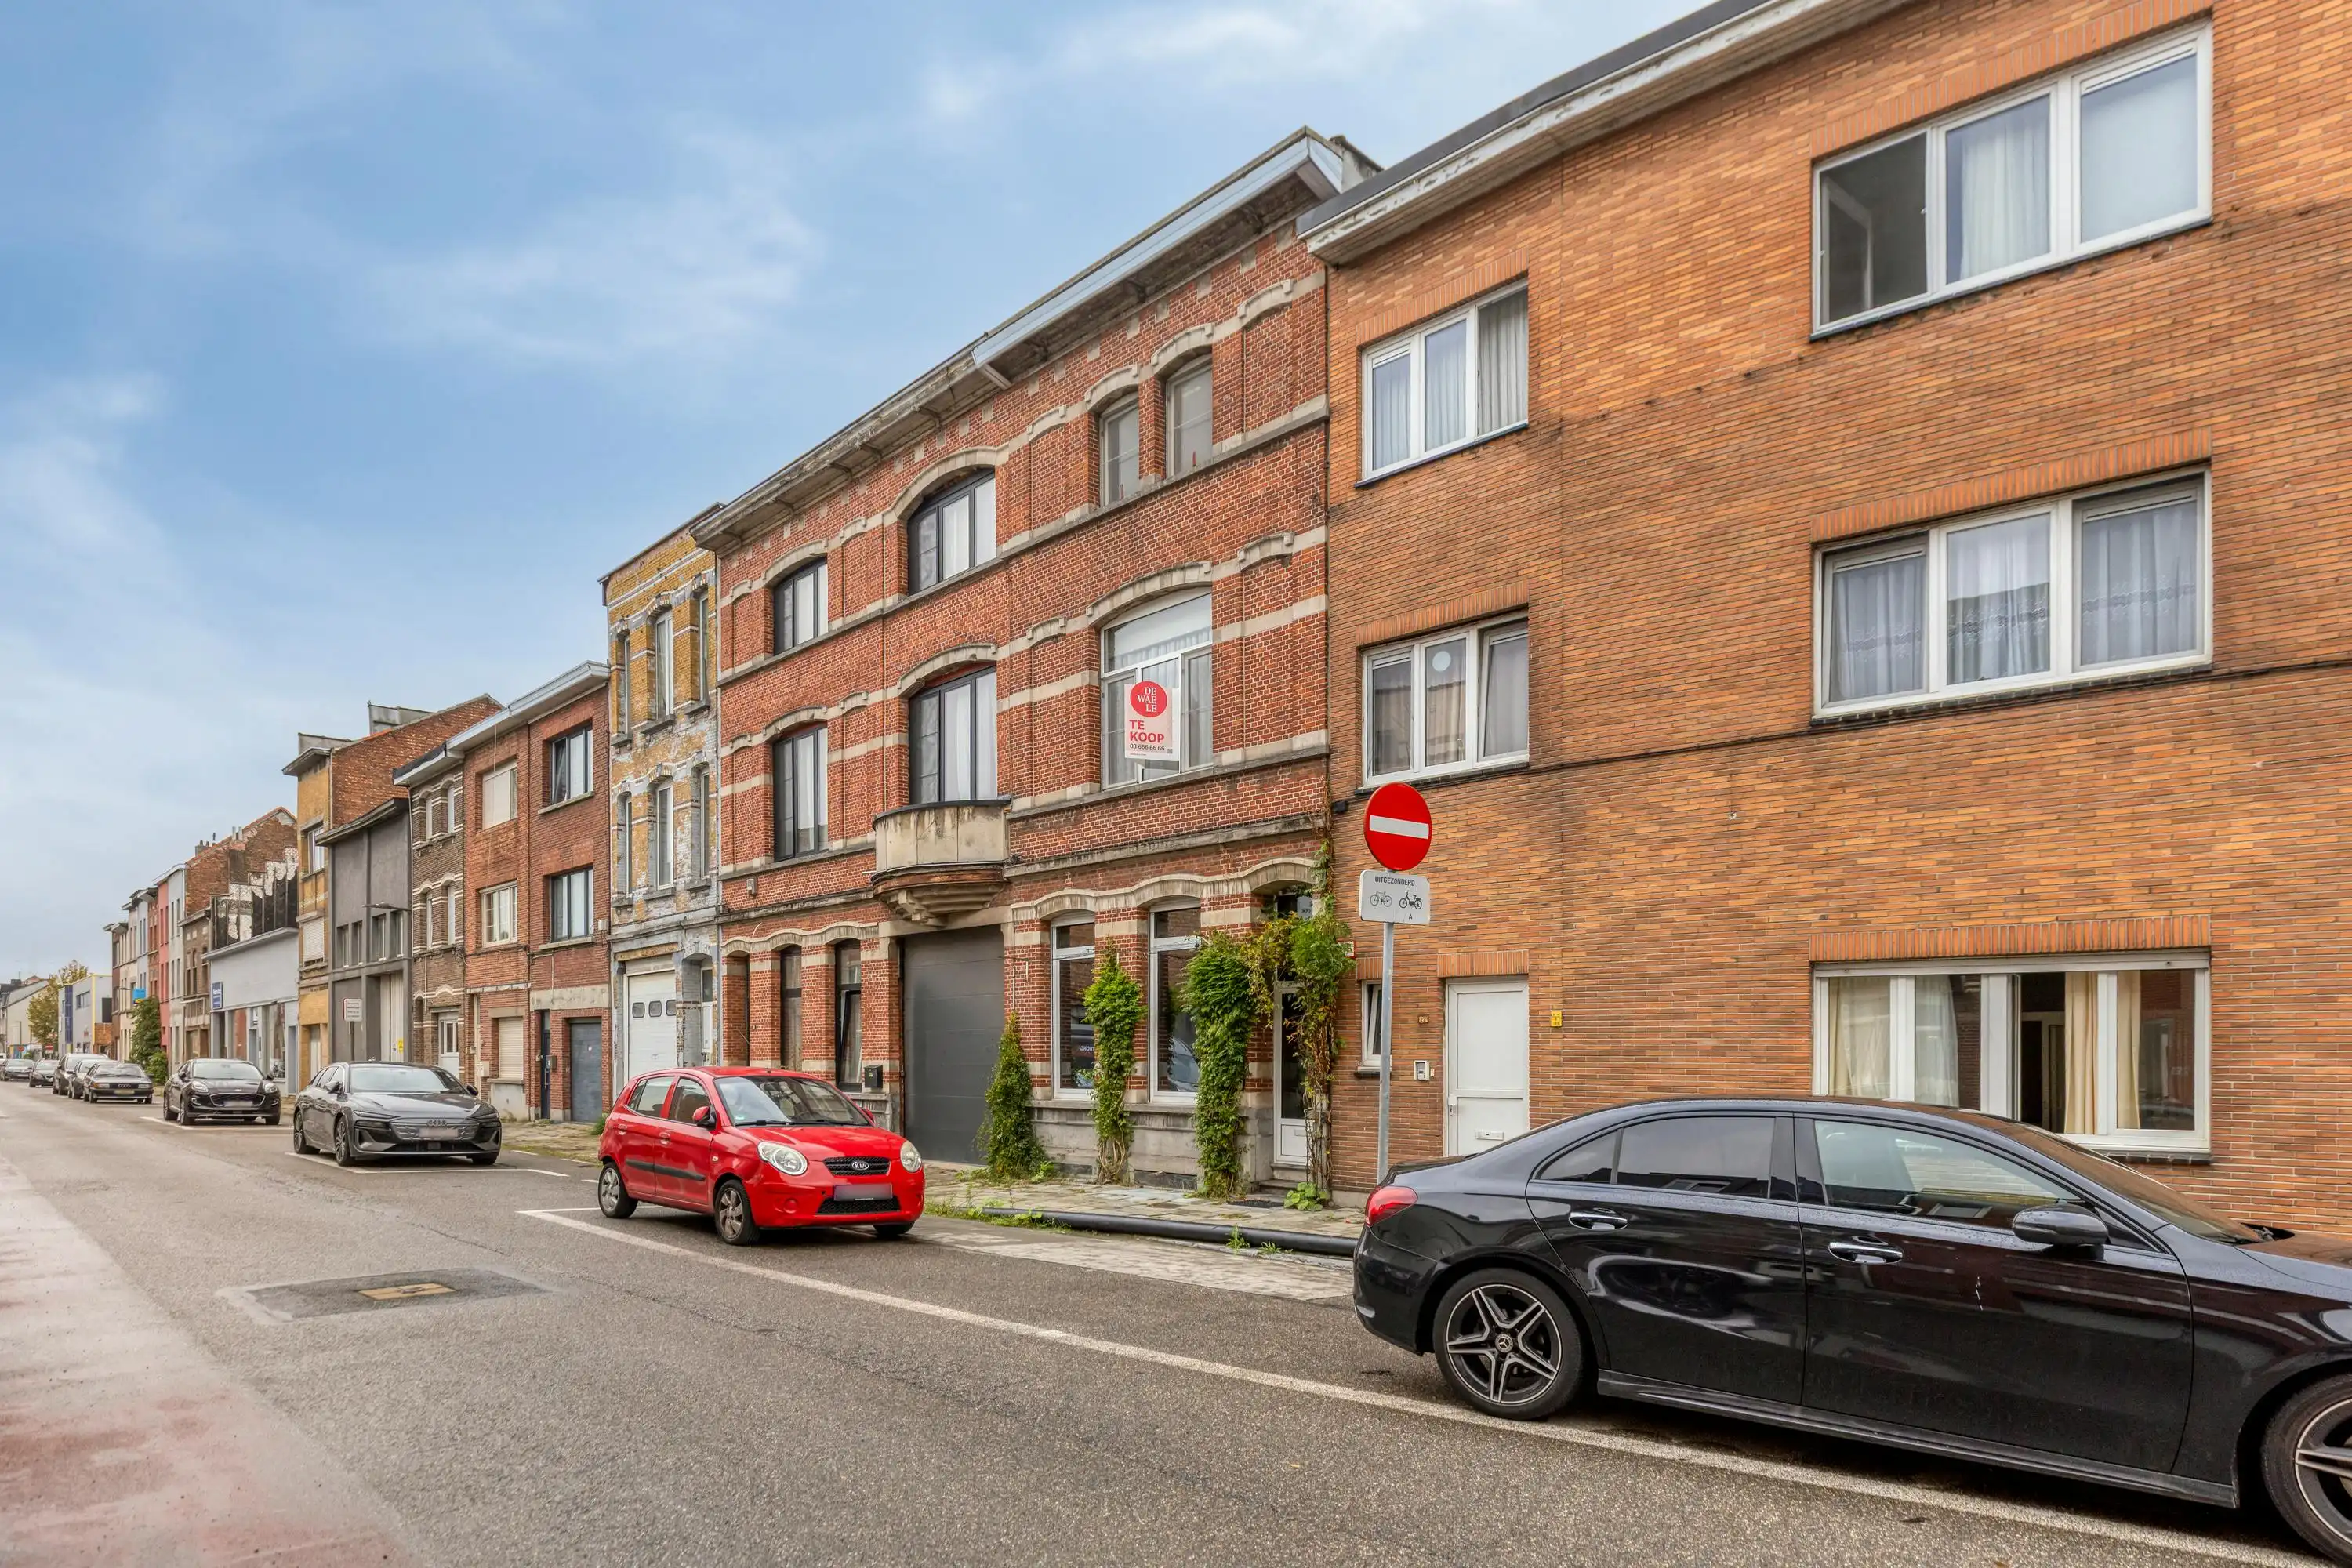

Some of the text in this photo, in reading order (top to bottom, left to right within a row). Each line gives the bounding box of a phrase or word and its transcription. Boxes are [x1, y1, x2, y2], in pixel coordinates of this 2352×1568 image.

[1145, 687, 1157, 695] DE
[1137, 695, 1157, 704] WAE
[1145, 704, 1157, 713] LE
[1129, 720, 1145, 730] TE
[1130, 731, 1164, 743] KOOP
[1374, 876, 1415, 886] UITGEZONDERD
